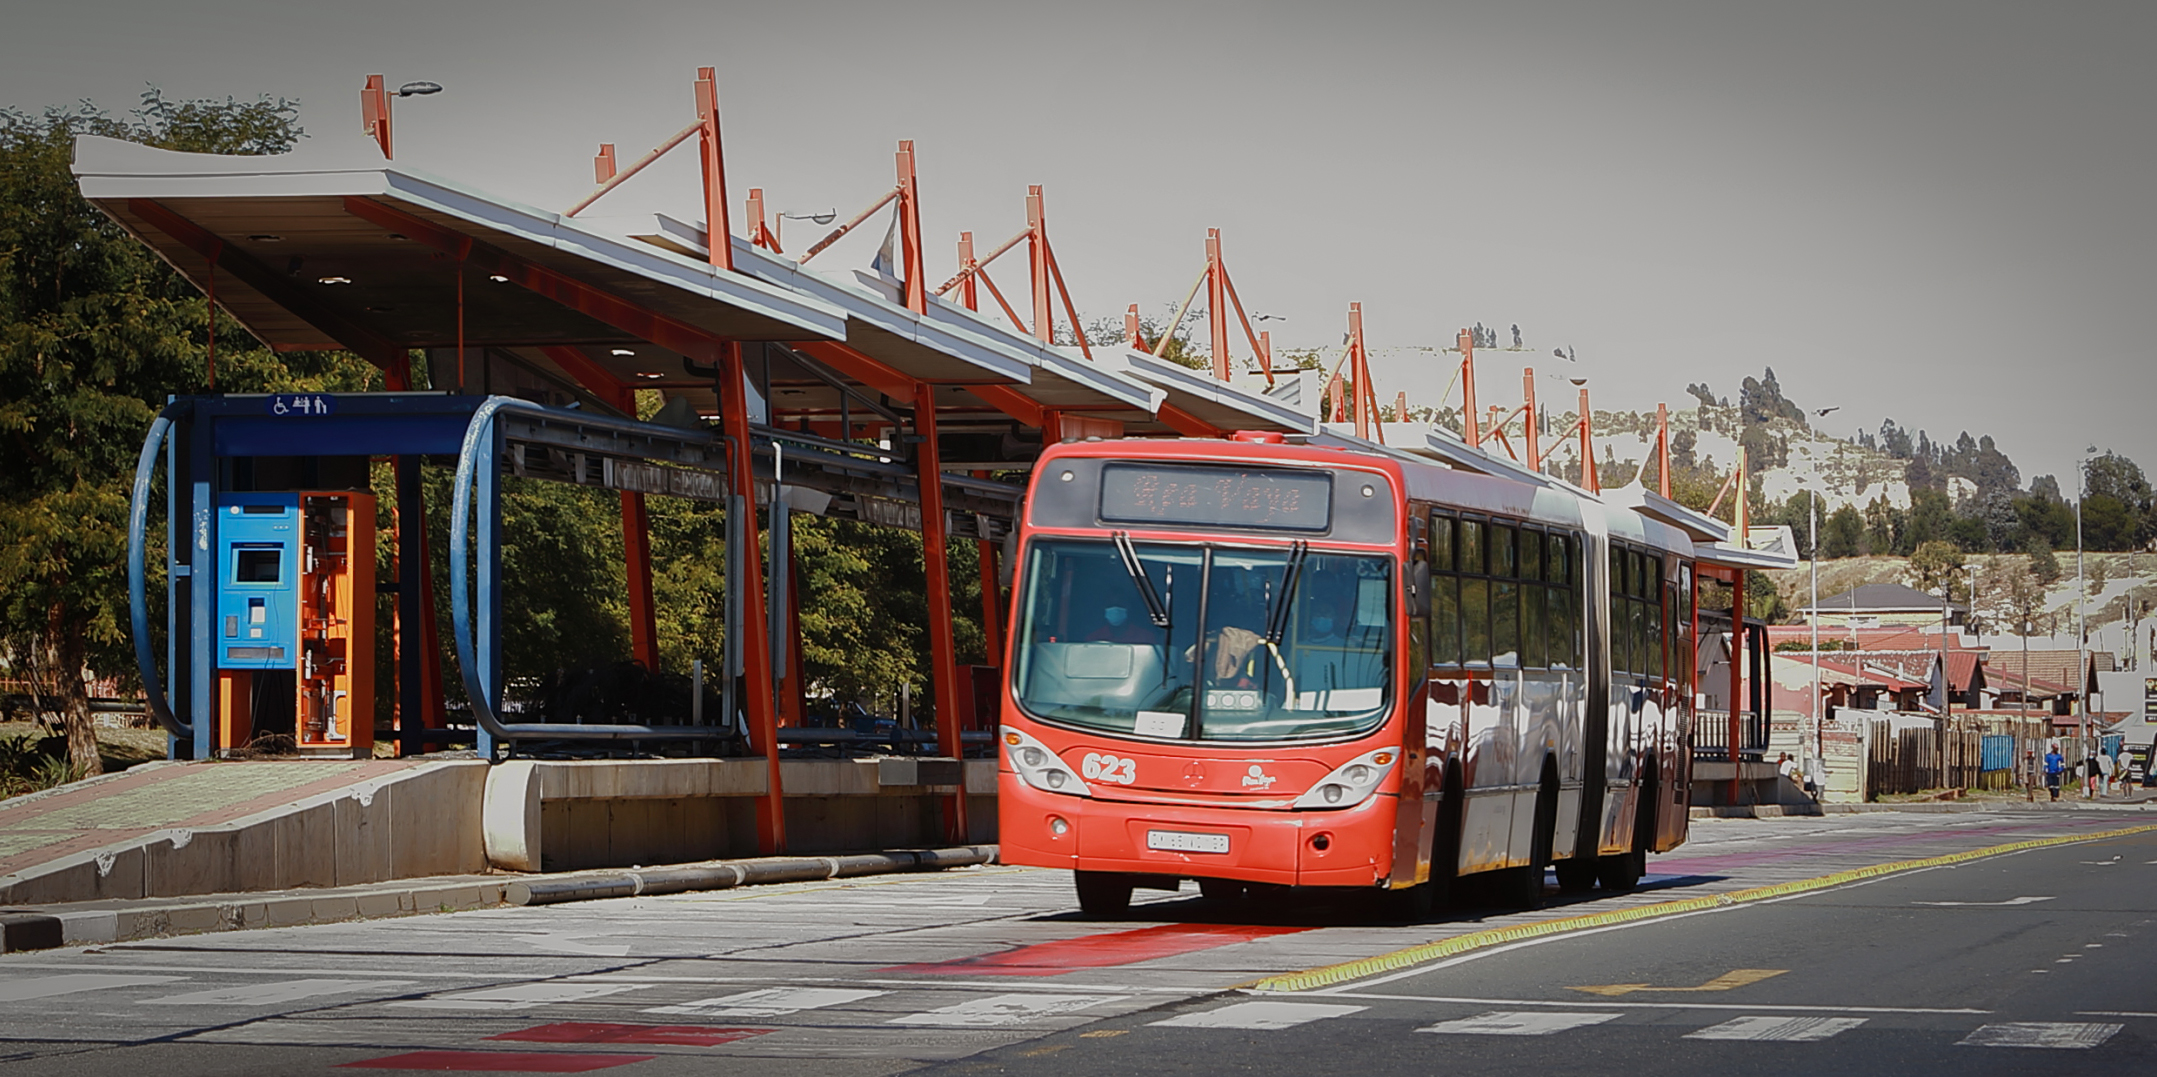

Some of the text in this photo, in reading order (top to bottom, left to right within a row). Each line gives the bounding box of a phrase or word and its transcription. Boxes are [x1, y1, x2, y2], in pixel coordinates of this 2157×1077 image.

[1134, 473, 1301, 524] Rea Vaya
[1082, 752, 1136, 785] 623
